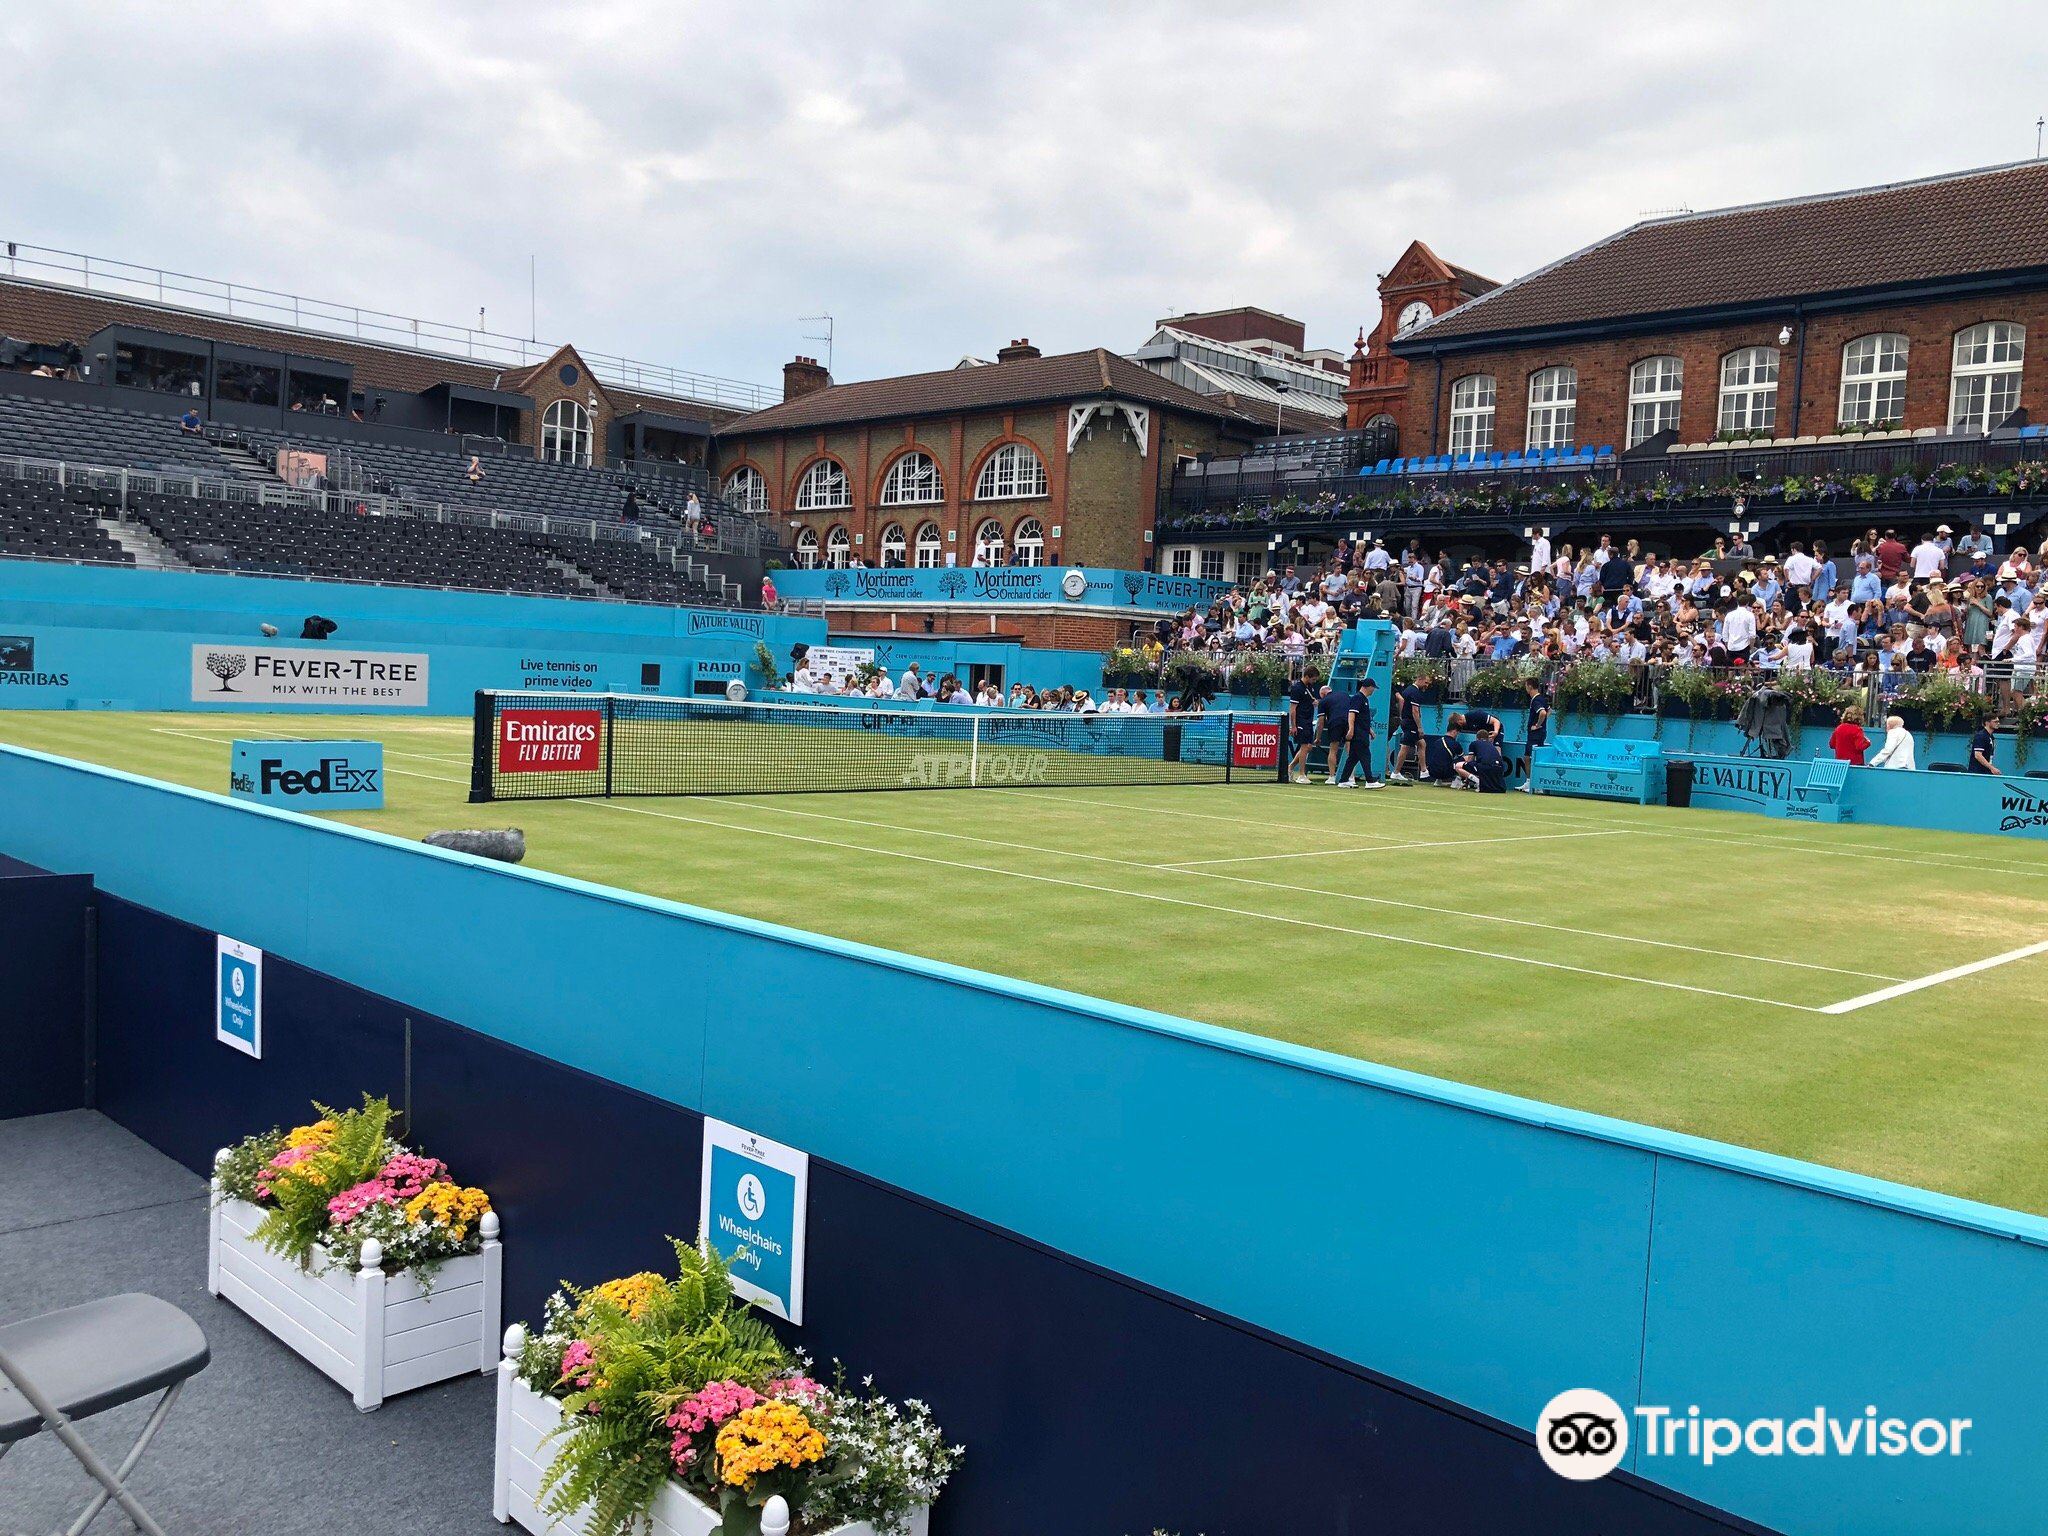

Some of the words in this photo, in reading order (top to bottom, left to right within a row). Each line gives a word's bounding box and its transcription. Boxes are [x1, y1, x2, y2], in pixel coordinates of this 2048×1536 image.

[855, 571, 914, 598] Mortimers
[878, 588, 905, 598] Orchard
[906, 589, 923, 598] cider
[973, 570, 1042, 599] Mortimers
[1000, 588, 1031, 599] Orchard
[1032, 589, 1053, 599] cider
[1087, 582, 1113, 590] RADO
[692, 615, 728, 631] NATURE
[729, 617, 762, 636] VALLEY
[254, 655, 418, 682] FEVER-TREE
[520, 659, 544, 671] Live
[546, 660, 581, 672] tennis
[583, 663, 598, 673] on
[698, 662, 741, 673] RADO
[272, 685, 296, 694] MIX
[303, 687, 337, 695] WITH
[343, 687, 366, 696] THE
[373, 688, 402, 697] BEST
[524, 675, 559, 688] prime
[561, 676, 593, 687] video
[506, 720, 596, 742] Emirates
[1236, 731, 1277, 746] Emirates
[519, 744, 540, 761] FLY
[541, 744, 582, 761] BETTER
[1250, 746, 1270, 759] BETTER
[260, 758, 378, 795] FedEx
[901, 755, 973, 784] ATP
[974, 753, 1050, 783] TOUR
[231, 771, 255, 793] FedEx
[1714, 767, 1785, 799] VALLEY
[719, 1213, 783, 1257] Wheelchairs
[736, 1244, 762, 1272] Only
